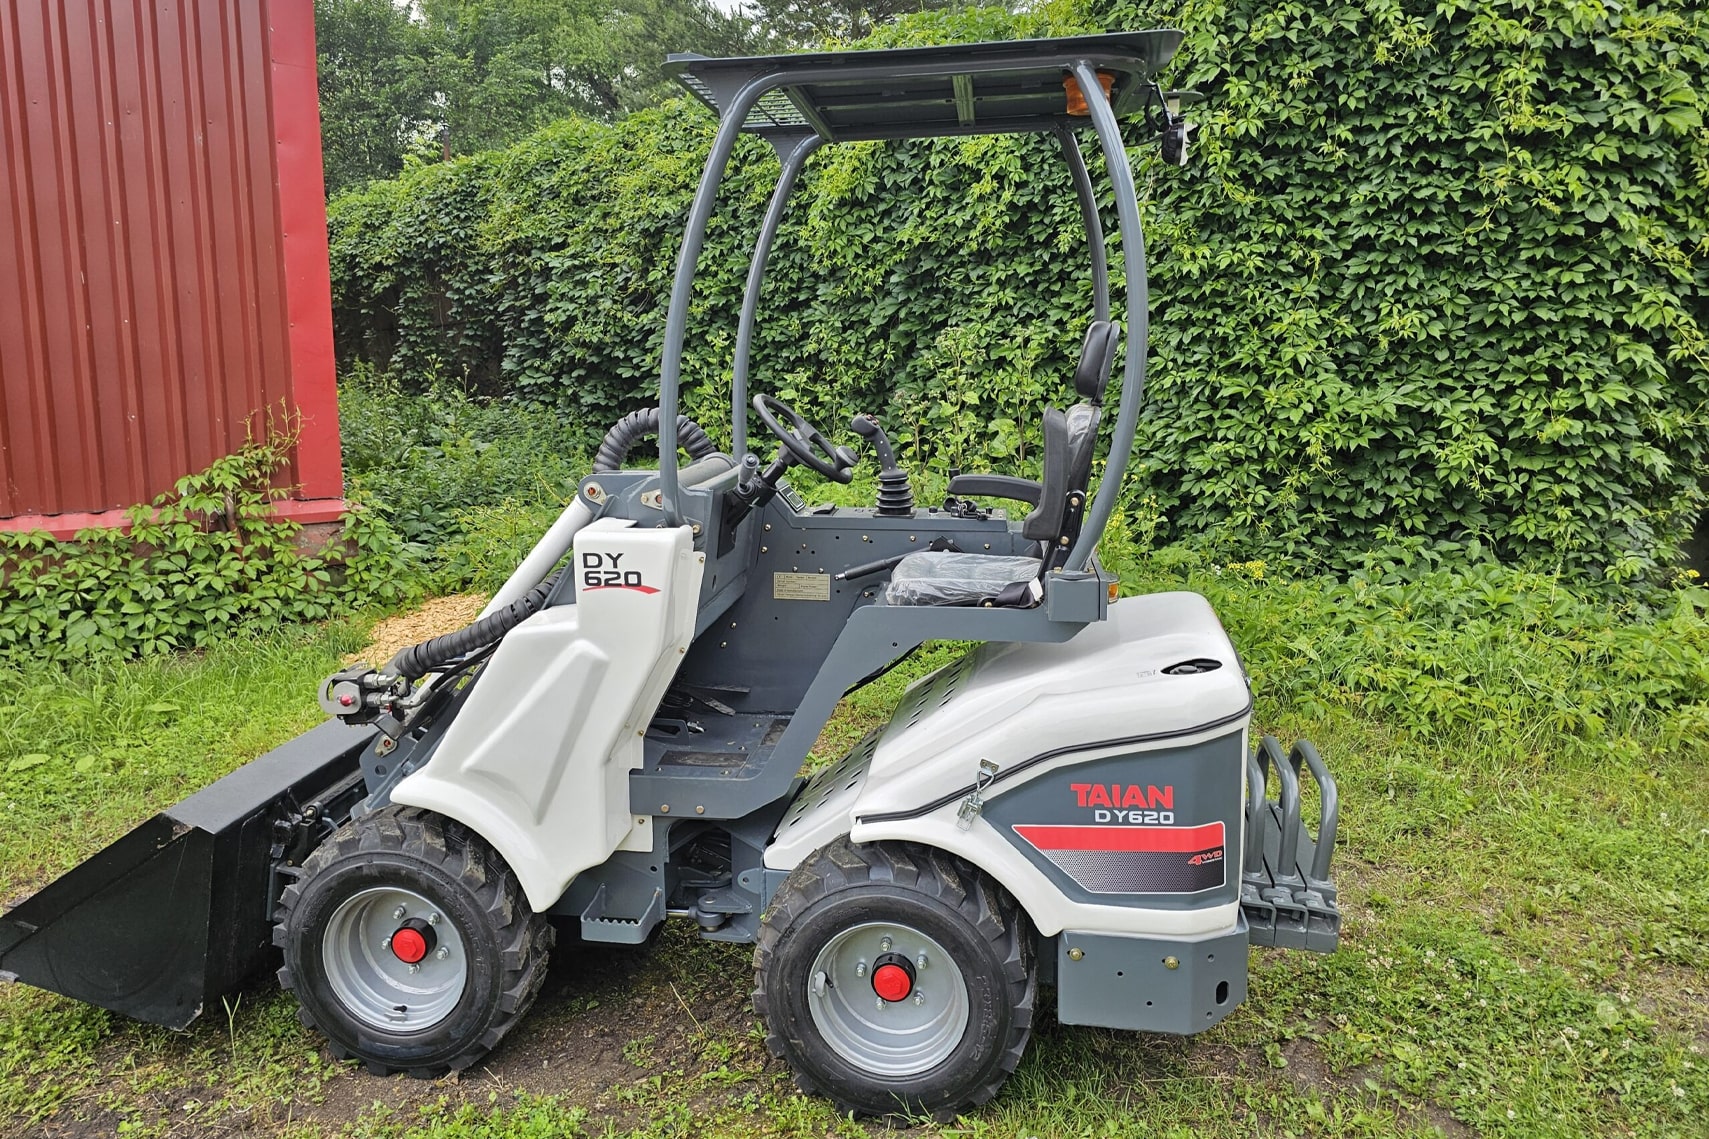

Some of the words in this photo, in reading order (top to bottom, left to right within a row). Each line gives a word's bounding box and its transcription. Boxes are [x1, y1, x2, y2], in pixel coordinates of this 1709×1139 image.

[582, 552, 625, 569] DY
[584, 570, 642, 587] 620
[1070, 783, 1174, 809] TAIAN
[1094, 809, 1175, 825] DY620
[1187, 849, 1223, 866] 4WD
